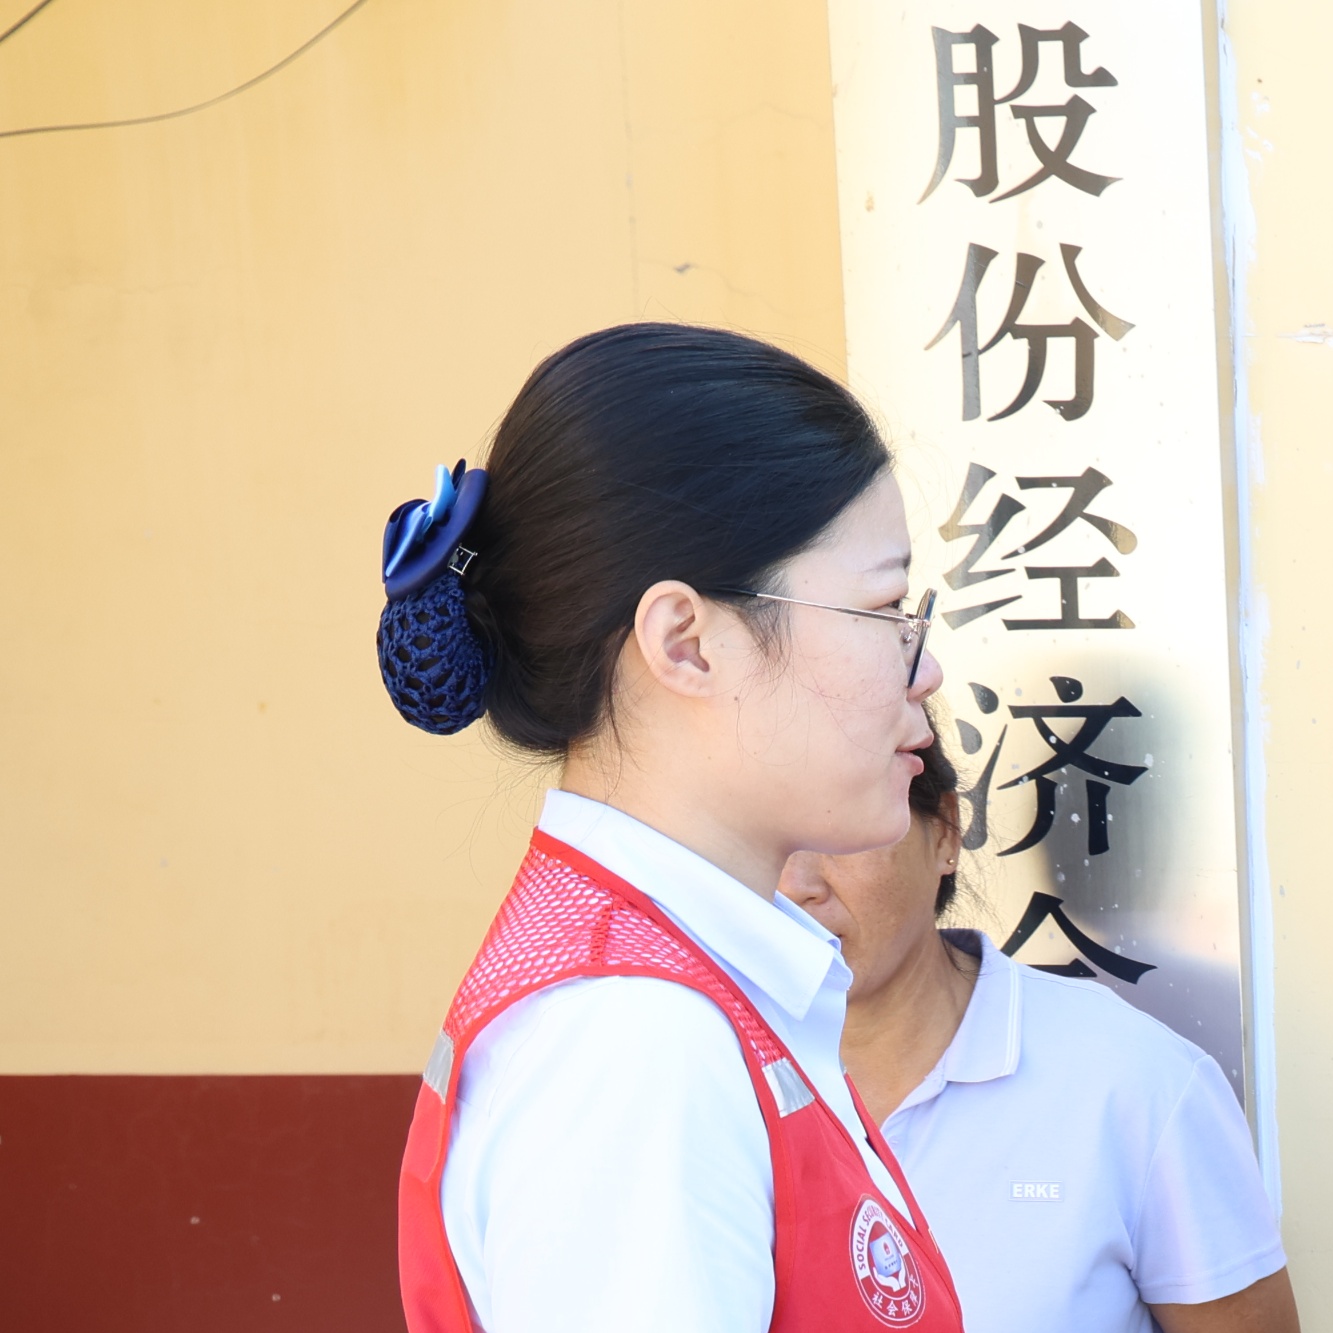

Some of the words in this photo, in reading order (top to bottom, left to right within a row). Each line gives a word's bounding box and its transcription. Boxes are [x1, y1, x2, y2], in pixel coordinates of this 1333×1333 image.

[1012, 1183, 1060, 1199] ERKE
[856, 1225, 867, 1271] SOCIAL
[884, 1217, 903, 1248] CARD
